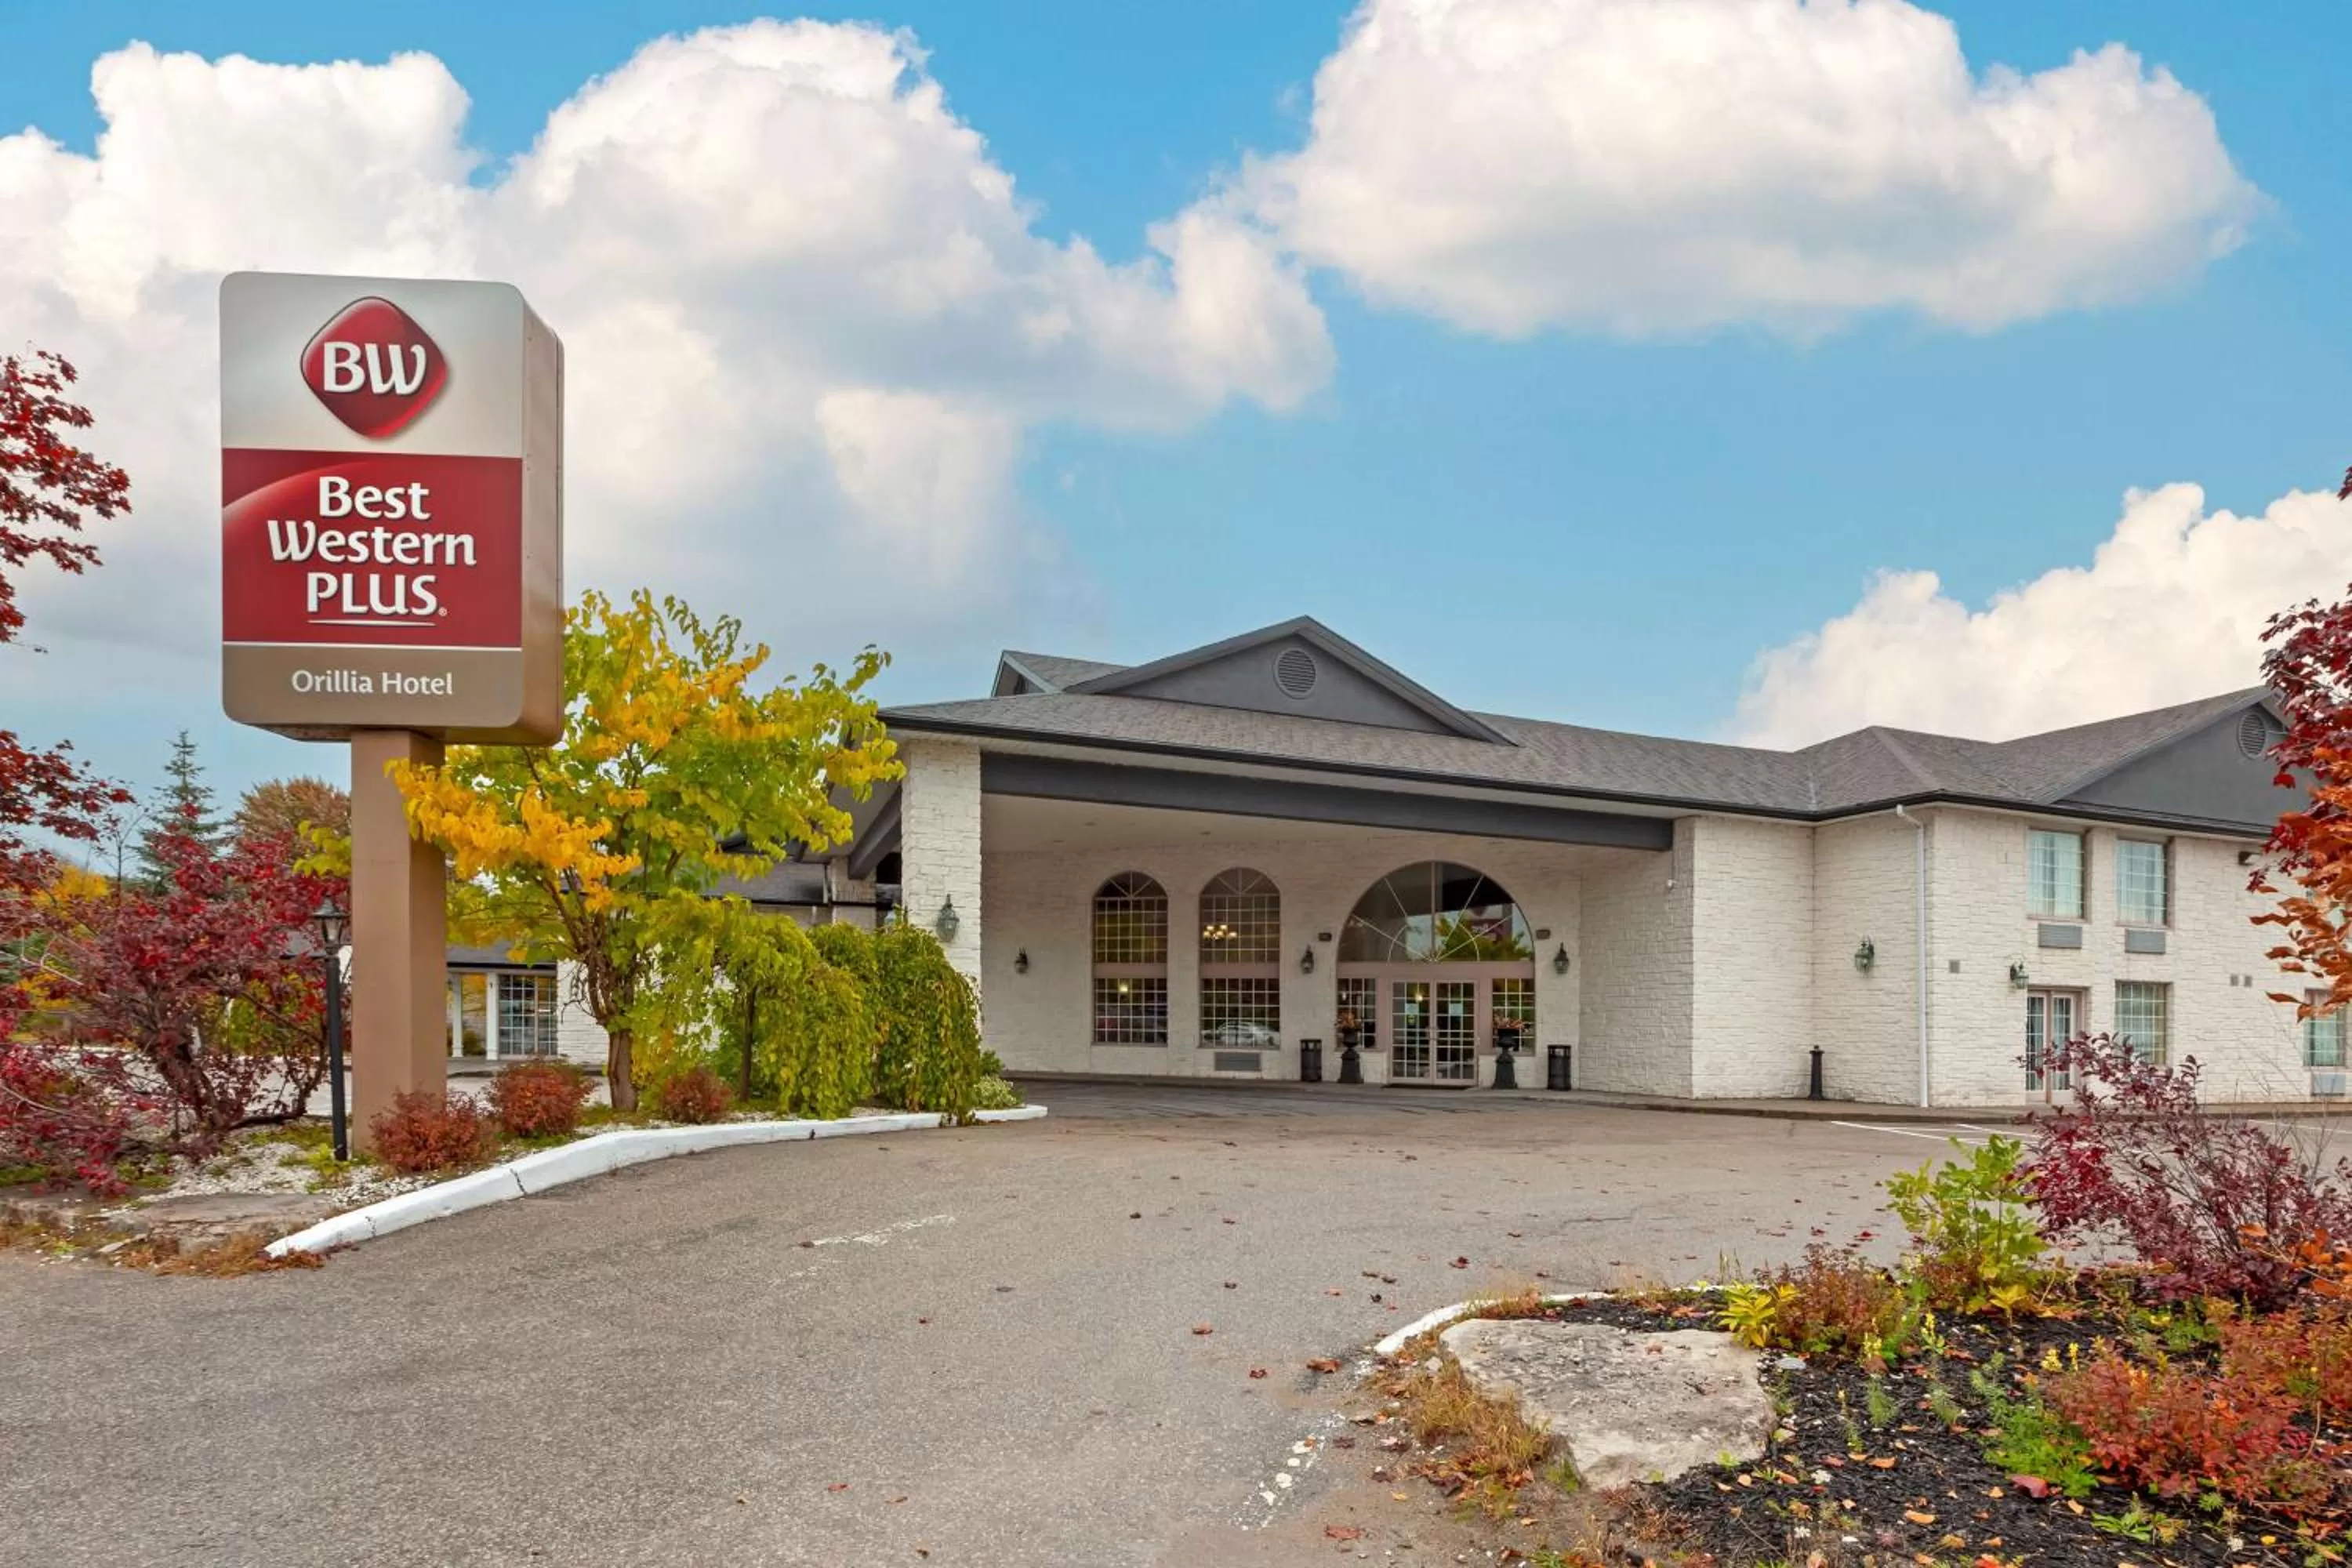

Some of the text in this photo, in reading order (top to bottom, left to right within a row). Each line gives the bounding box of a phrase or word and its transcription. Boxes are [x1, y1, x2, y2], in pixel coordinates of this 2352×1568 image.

[322, 340, 427, 396] BW
[318, 475, 431, 521] Best
[267, 519, 477, 566] Western
[292, 670, 453, 695] Orillia Hotel
